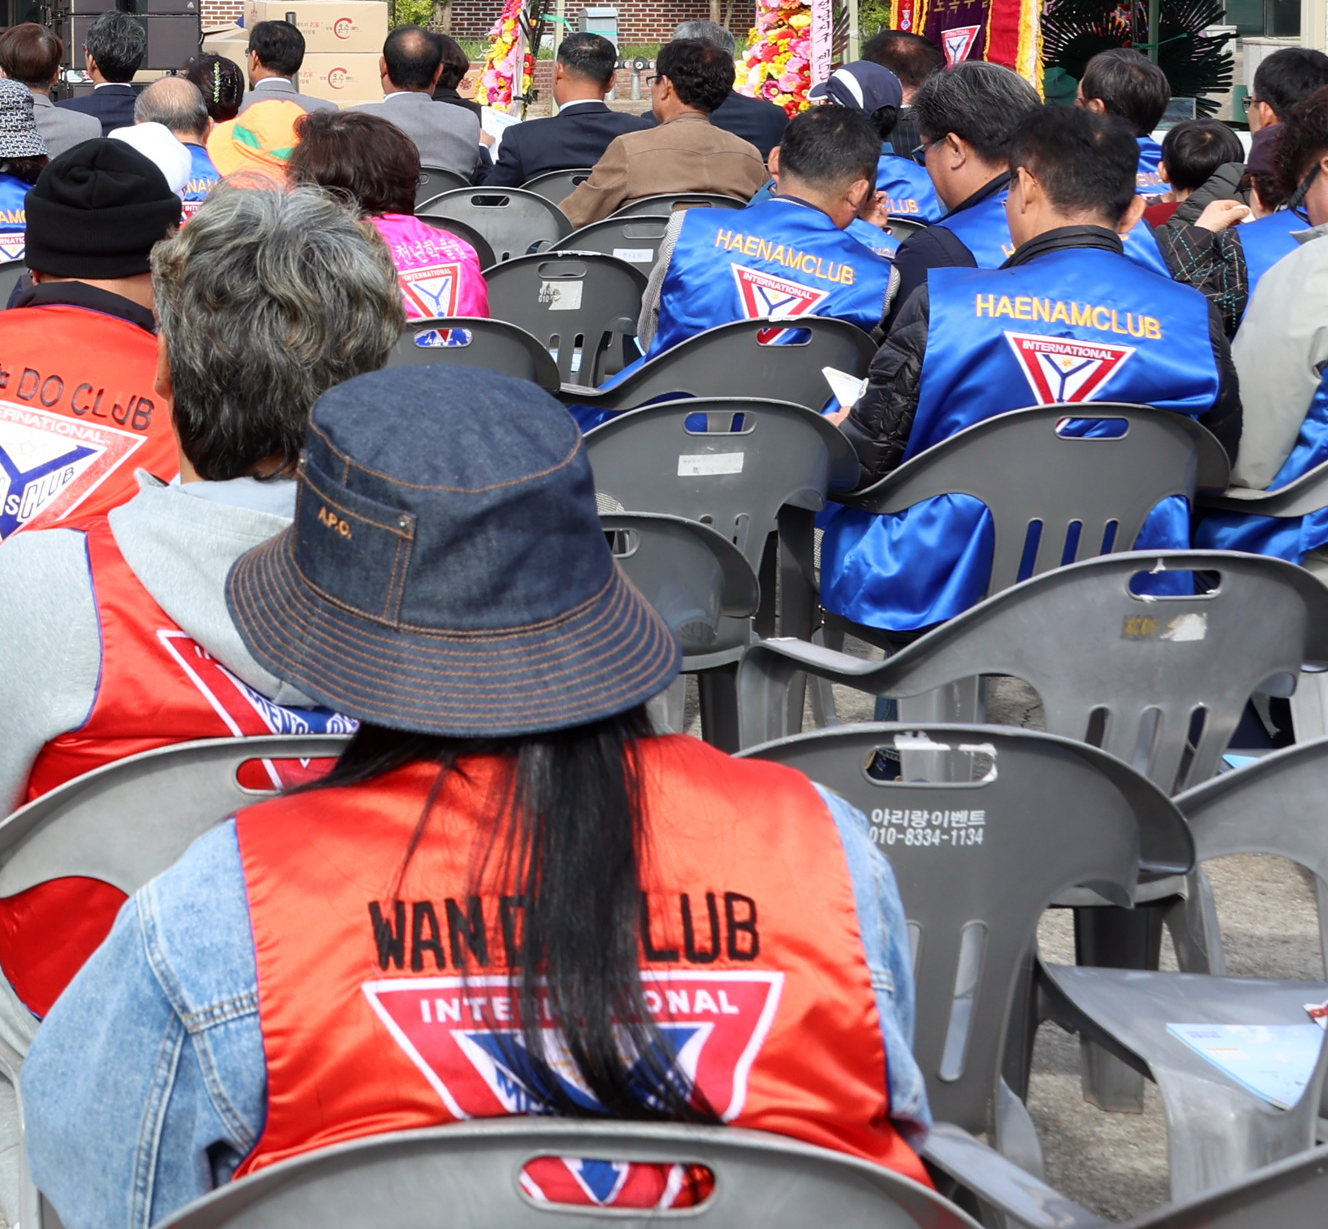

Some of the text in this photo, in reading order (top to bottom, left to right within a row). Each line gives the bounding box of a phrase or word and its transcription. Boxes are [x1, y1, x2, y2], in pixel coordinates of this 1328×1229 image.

[714, 229, 857, 286] HAENAMCLUB
[742, 272, 813, 300] INTERNATIONAL
[976, 293, 1163, 340] HAENAMCLUB
[1022, 339, 1116, 361] INTERNATIONAL
[15, 367, 64, 408] DO
[71, 382, 156, 431] CLUB
[869, 826, 985, 846] 010-8334-1134
[369, 894, 490, 971] WAN
[642, 891, 760, 965] LUB
